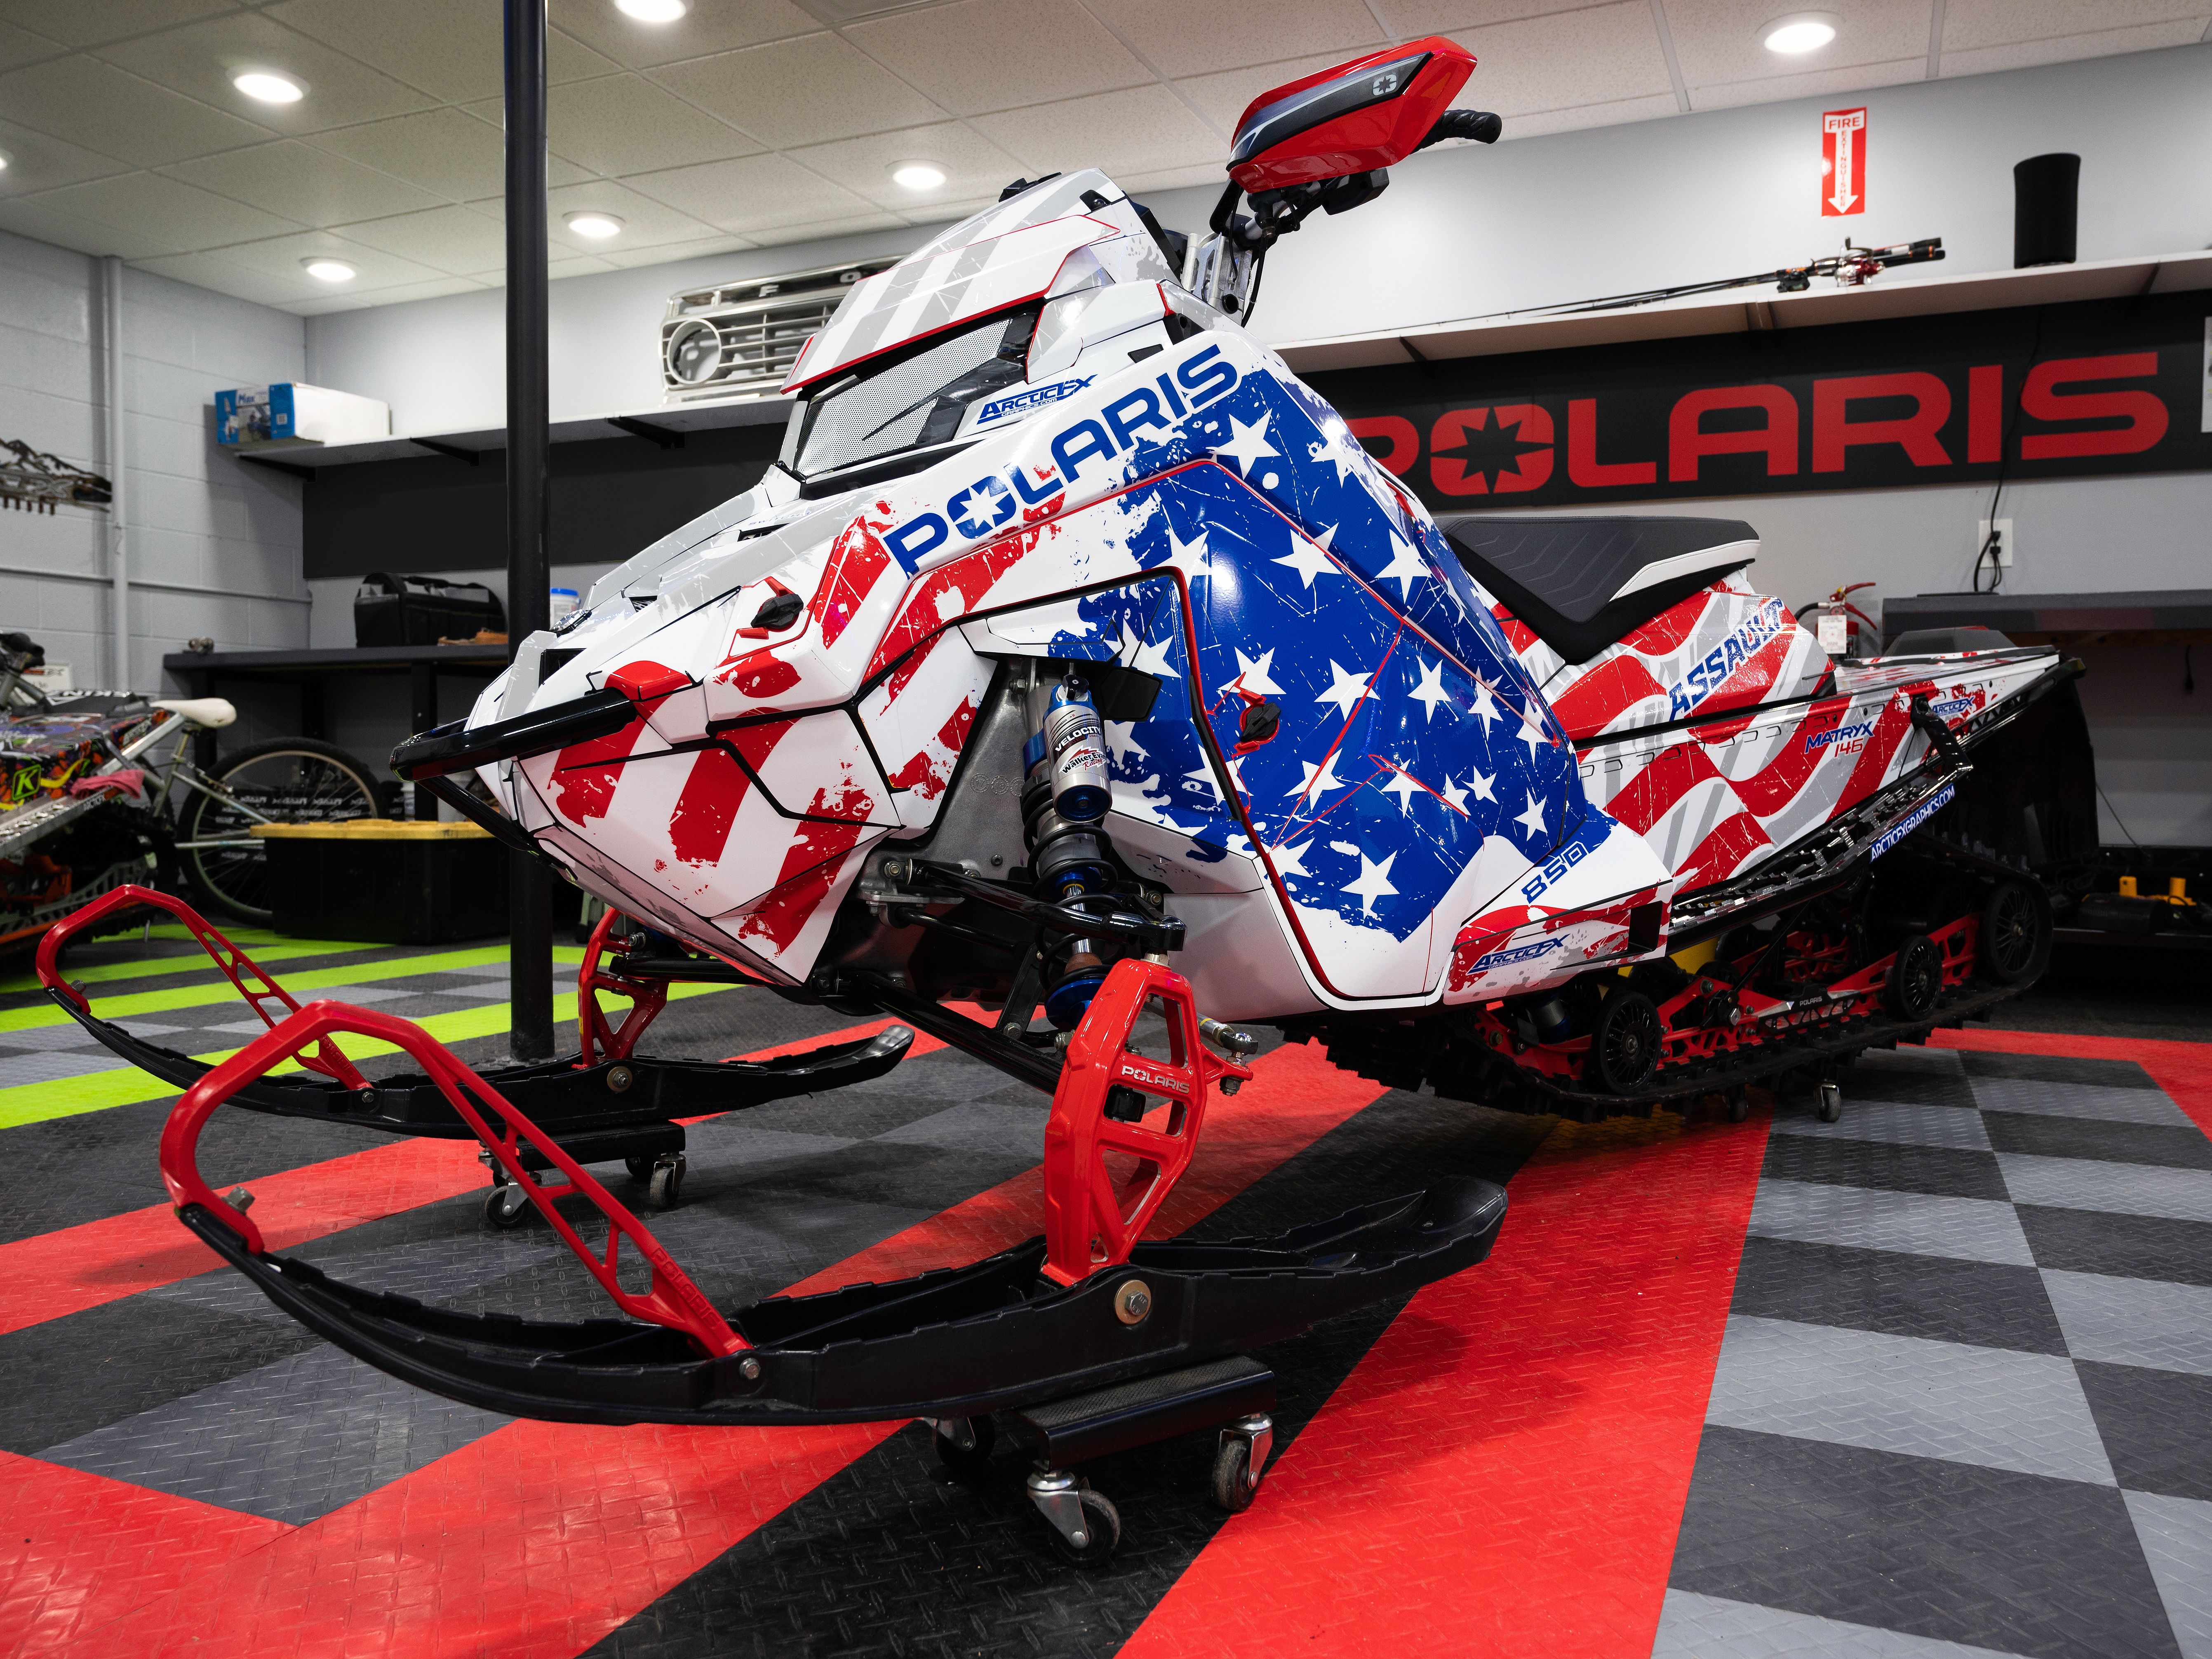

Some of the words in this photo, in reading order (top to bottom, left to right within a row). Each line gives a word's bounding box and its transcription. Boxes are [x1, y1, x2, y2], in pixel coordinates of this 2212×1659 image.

[1829, 116, 1860, 130] FIRE
[1001, 398, 1057, 417] GRAPHICS.COM
[1345, 352, 2169, 496] POLARIS
[883, 344, 1237, 580] POLARIS
[1669, 599, 1783, 721] ASSAULT
[1055, 726, 1100, 752] VELOCITY
[1804, 721, 1874, 754] MATRYX
[1834, 738, 1864, 758] 146
[1063, 754, 1093, 774] Walker
[1082, 758, 1103, 771] Racing
[15, 768, 39, 796] K
[1870, 785, 1955, 863] ARCTICFXGRAPHICS.COM
[1521, 841, 1588, 904] 850
[1488, 956, 1533, 969] GRAPHICS.COM
[1799, 996, 1822, 1006] POLARIS
[1121, 1065, 1190, 1094] POLARIS
[649, 1248, 721, 1328] POLARIS
